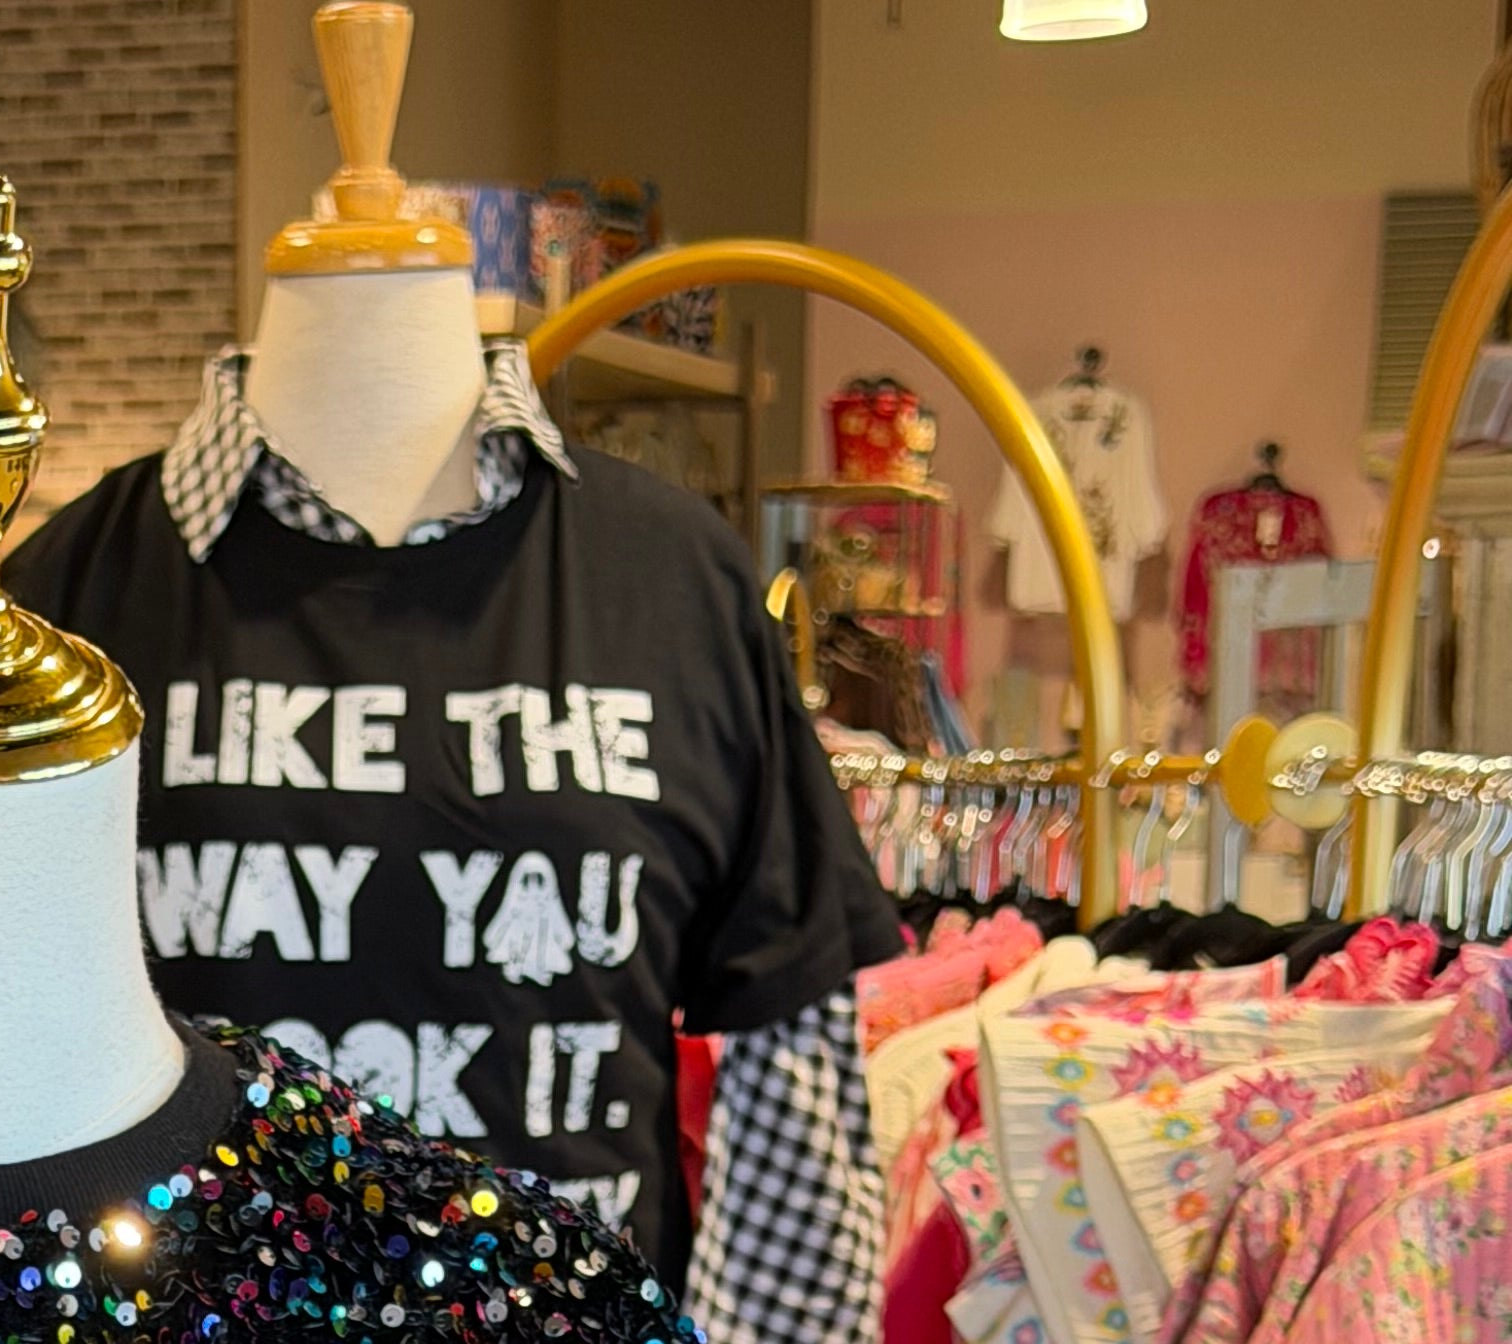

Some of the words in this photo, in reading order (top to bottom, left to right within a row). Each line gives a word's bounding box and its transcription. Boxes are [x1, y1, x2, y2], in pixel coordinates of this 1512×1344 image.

[161, 678, 408, 793] LIKE
[445, 683, 661, 801] THE
[136, 840, 380, 963] WAY
[525, 1019, 630, 1138] IT.
